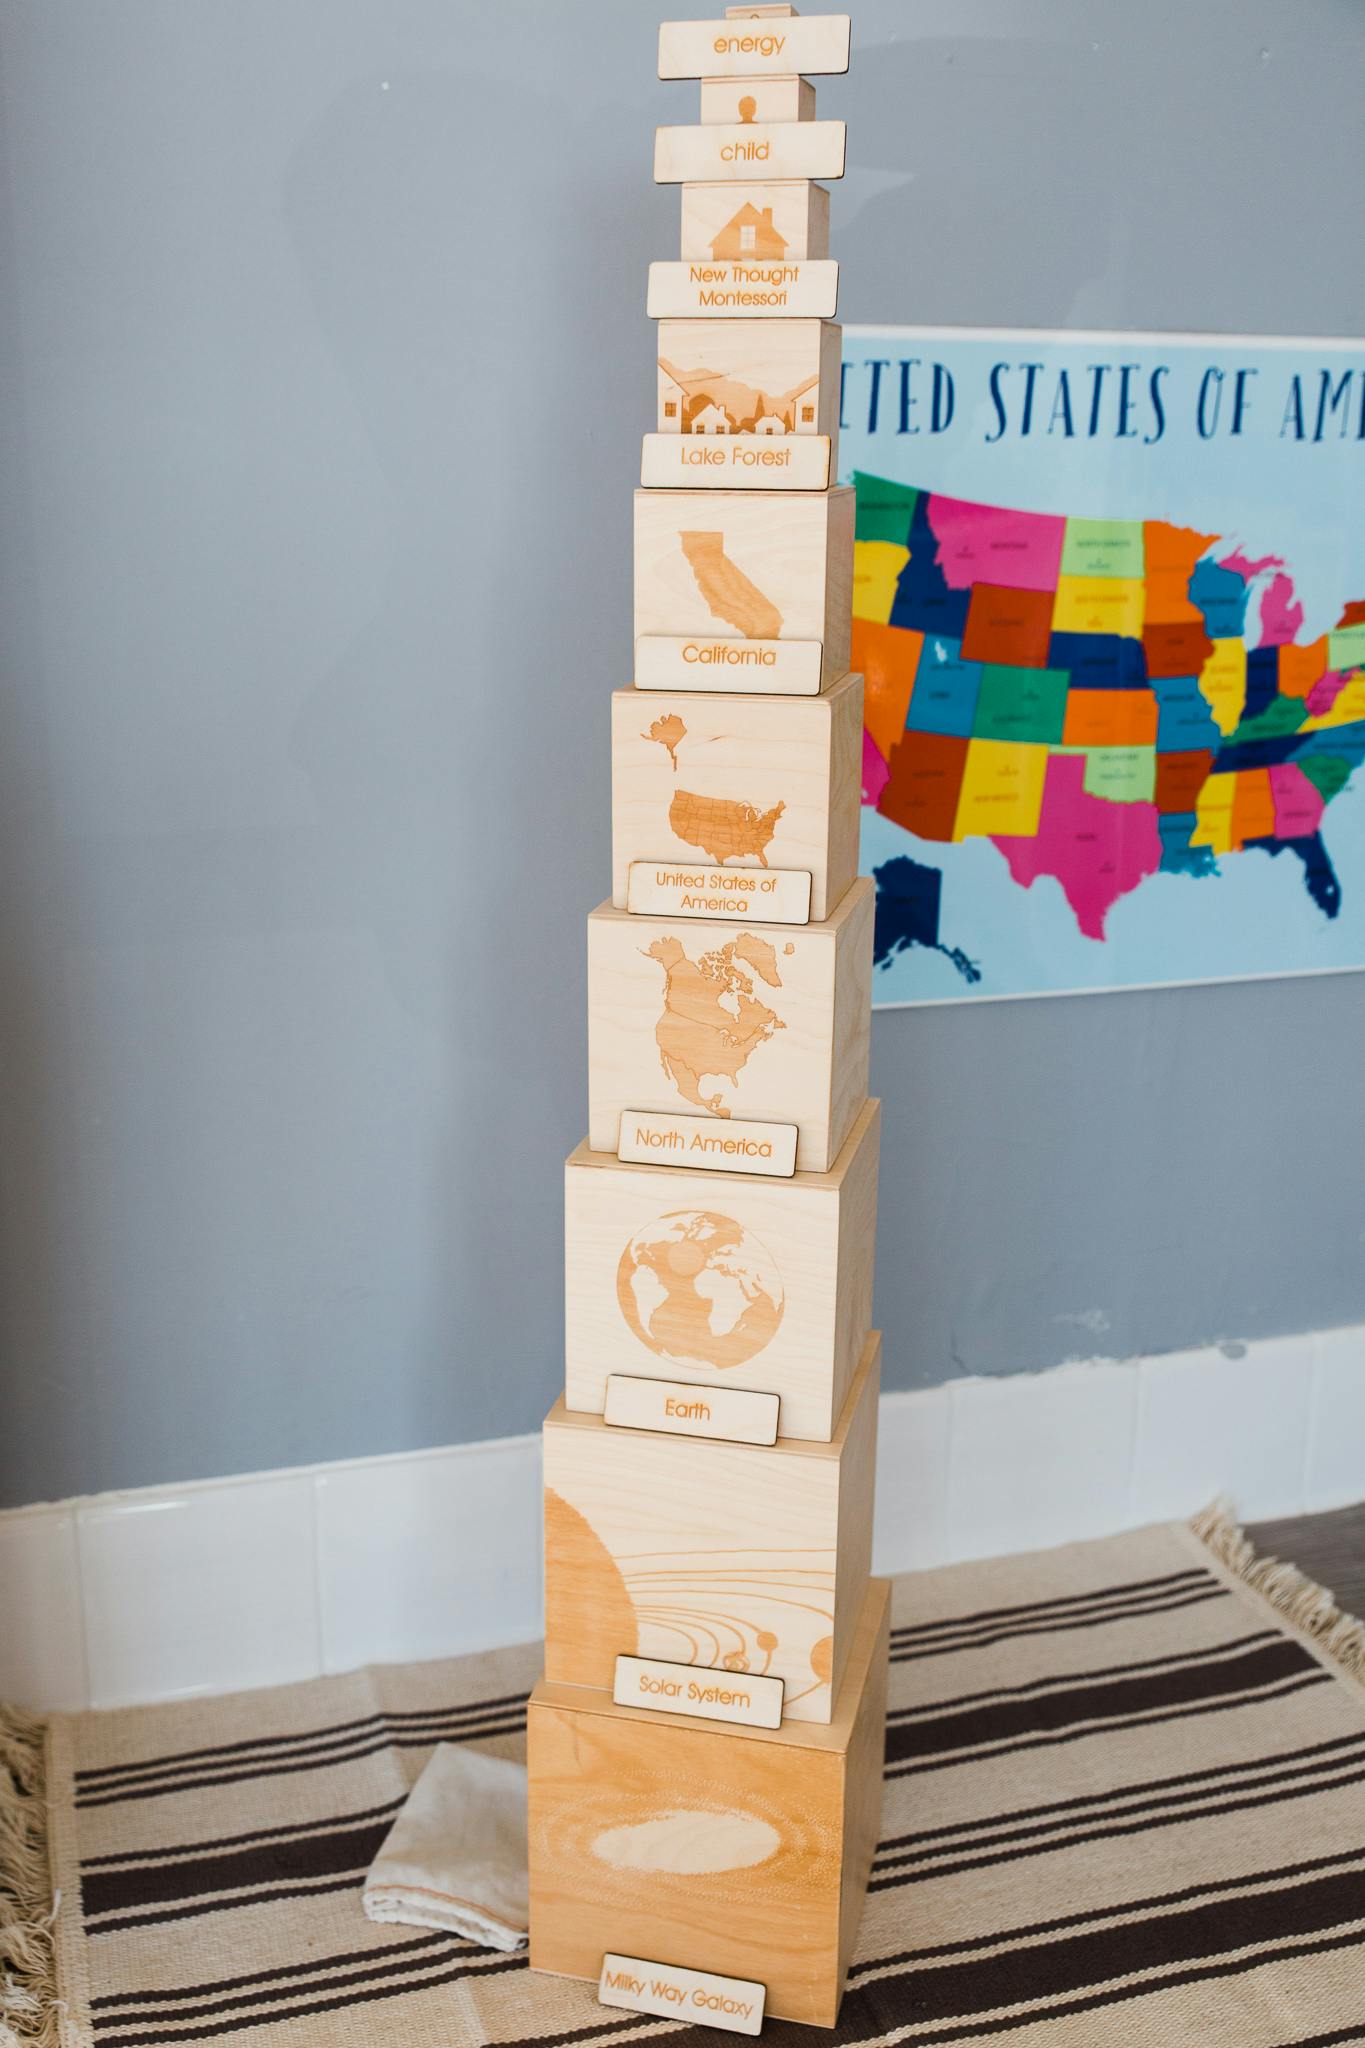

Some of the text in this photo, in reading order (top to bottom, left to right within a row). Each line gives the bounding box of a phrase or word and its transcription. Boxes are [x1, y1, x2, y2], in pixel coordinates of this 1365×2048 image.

[714, 36, 787, 57] energy
[720, 141, 770, 161] child
[690, 266, 800, 285] New Thought
[699, 290, 787, 306] Montessori
[984, 361, 1170, 445] STATES
[1196, 366, 1259, 441] OF
[1279, 368, 1365, 443] AM
[681, 447, 792, 467] Lake Forest
[682, 644, 777, 666] California
[656, 871, 778, 893] United States of
[680, 895, 749, 913] America
[635, 1128, 773, 1158] North America
[665, 1399, 711, 1421] Earth
[639, 1675, 750, 1709] Solar System
[605, 1971, 755, 2020] Milky Way Galaxy
